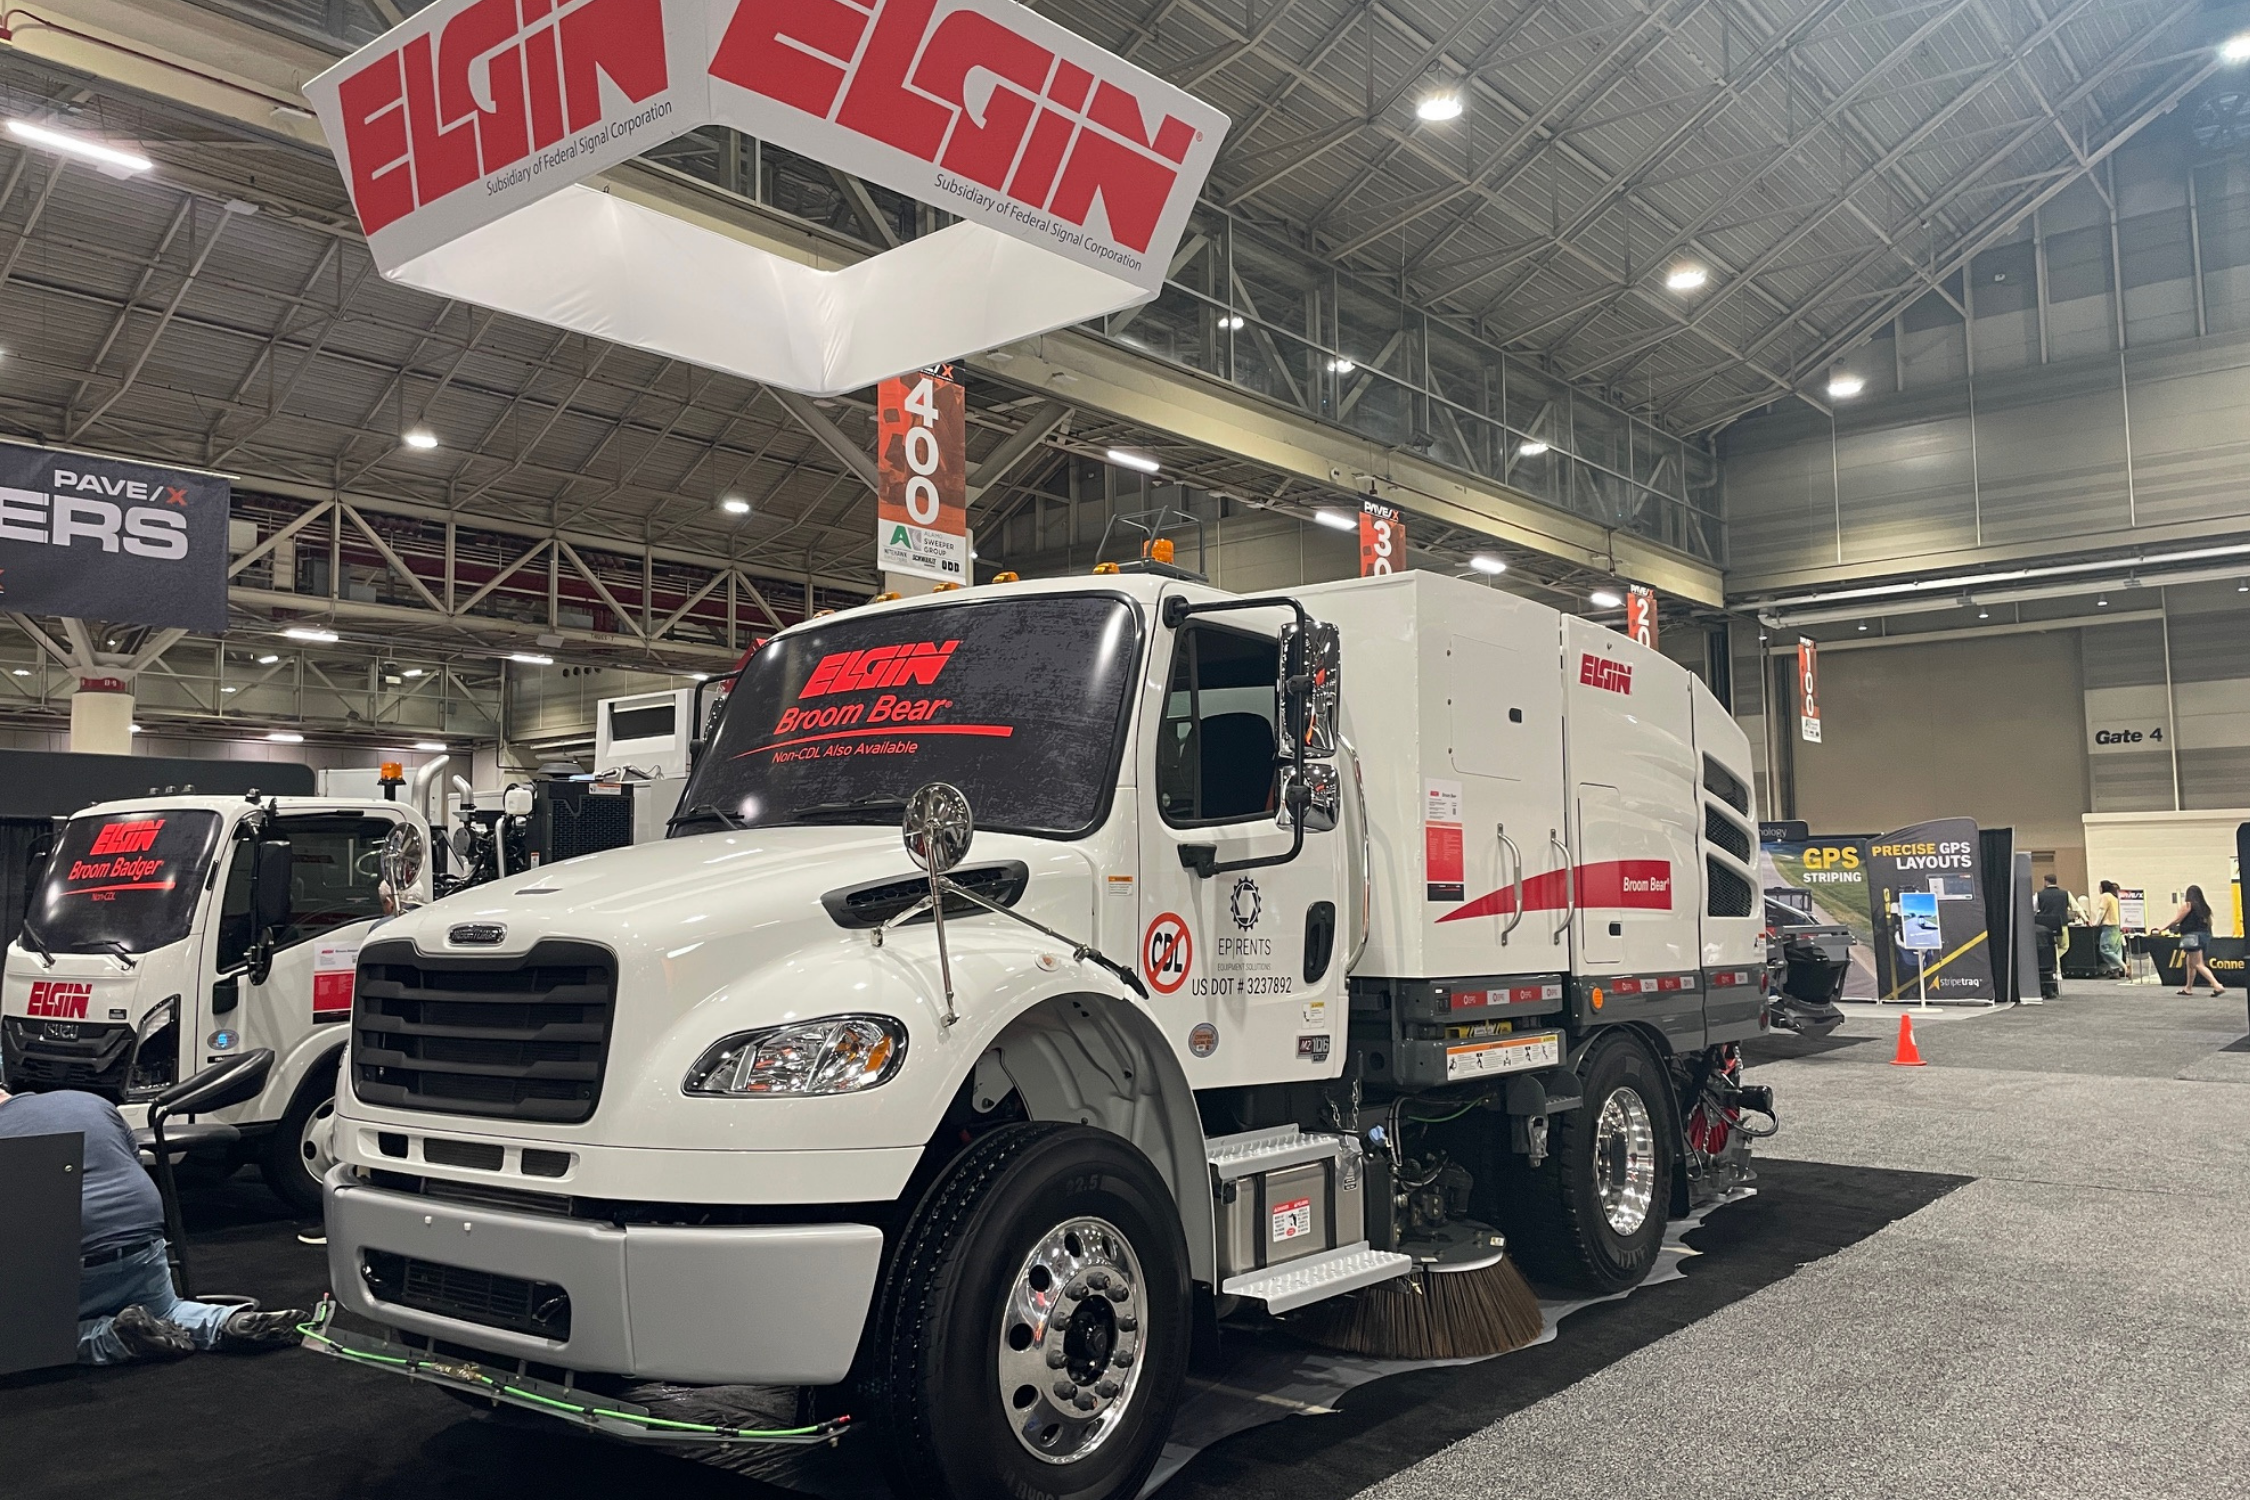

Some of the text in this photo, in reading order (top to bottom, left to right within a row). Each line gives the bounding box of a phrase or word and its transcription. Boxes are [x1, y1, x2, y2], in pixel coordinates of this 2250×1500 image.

[338, 0, 669, 237] ELGIN
[486, 101, 673, 197] Subsidiary of Federal Signal Corporation
[934, 173, 1142, 271] Subsidiary of Federal Signal Corporation
[54, 469, 188, 506] PAVE/X
[923, 546, 947, 556] GROUP
[924, 538, 955, 550] SWEEPER
[798, 640, 961, 699] ELGIN
[1580, 653, 1632, 695] ELGIN
[773, 702, 865, 735] Broom
[2095, 727, 2163, 745] Gate 4
[771, 741, 918, 764] Non-CDL Also Available
[89, 819, 166, 856] ELGIN
[1871, 842, 1971, 857] PRECISE GPS
[67, 856, 164, 881] Broom Badger
[1803, 846, 1860, 869] GPS
[1896, 854, 1972, 870] LAYOUTS
[1623, 876, 1649, 892] Broom
[1803, 871, 1862, 883] STRIPING
[1151, 931, 1183, 972] CDL
[1245, 963, 1271, 971] SOLUTIONS
[1192, 976, 1292, 996] US DOT # 3237892
[27, 981, 92, 1019] ELGIN
